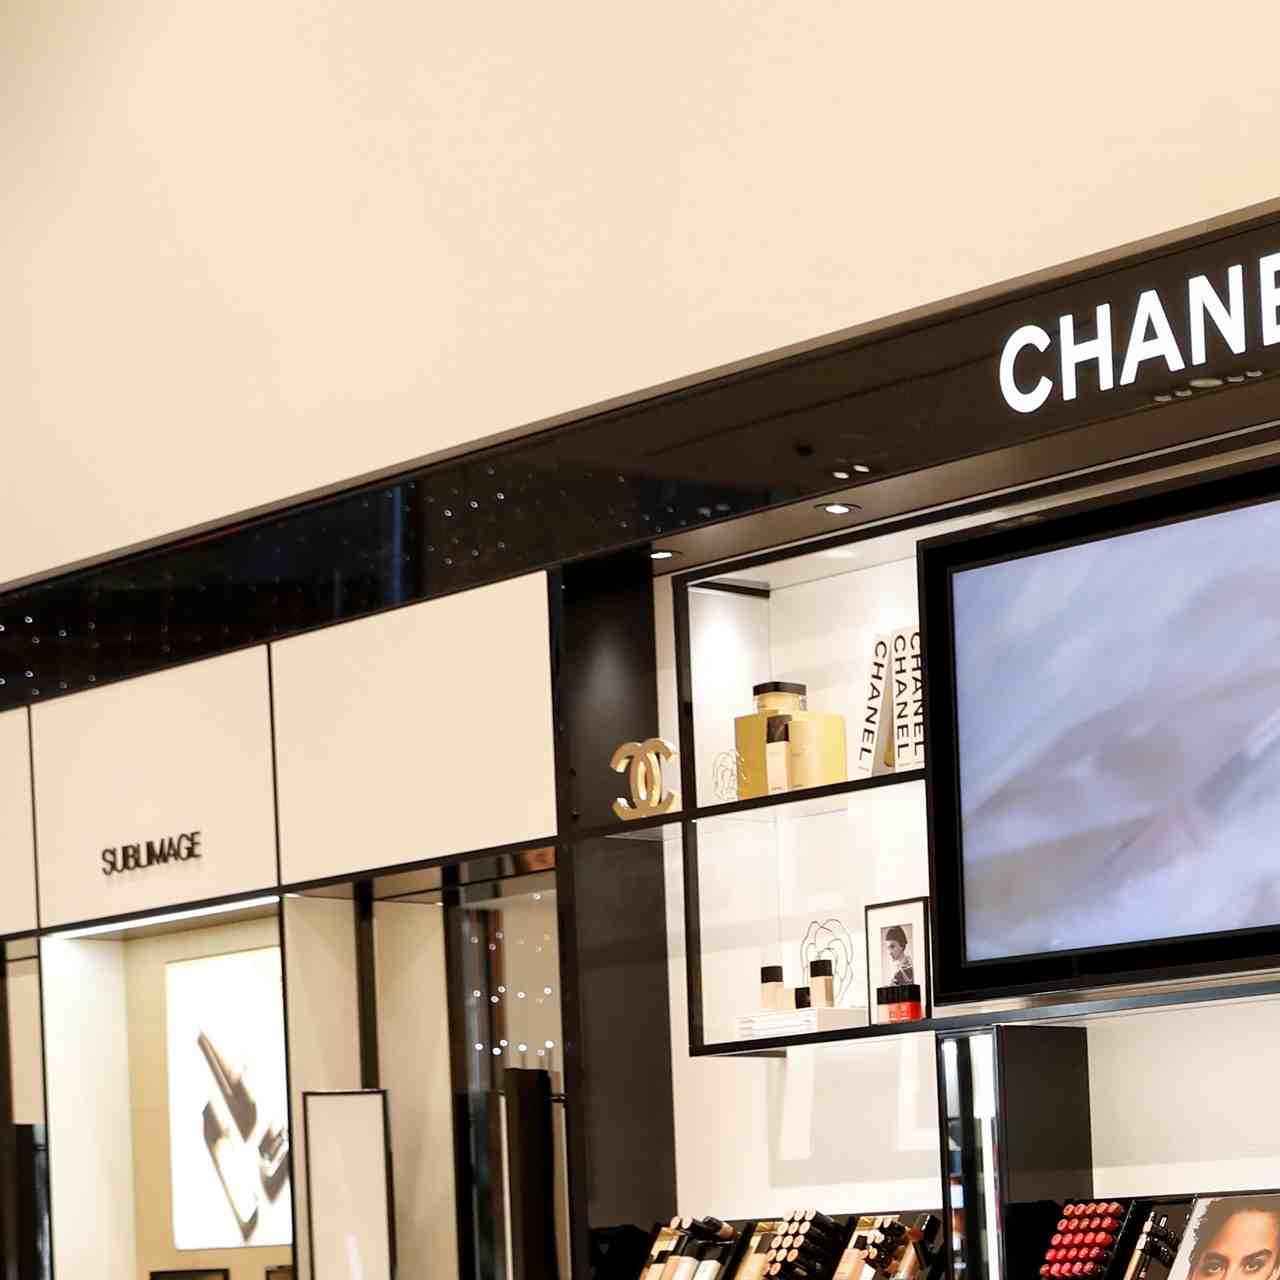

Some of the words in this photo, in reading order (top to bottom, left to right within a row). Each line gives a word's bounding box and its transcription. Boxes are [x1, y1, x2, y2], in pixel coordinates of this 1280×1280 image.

[859, 640, 888, 762] CHANEL
[894, 635, 909, 759] CHANEL
[102, 831, 201, 876] SUBLIMAGE
